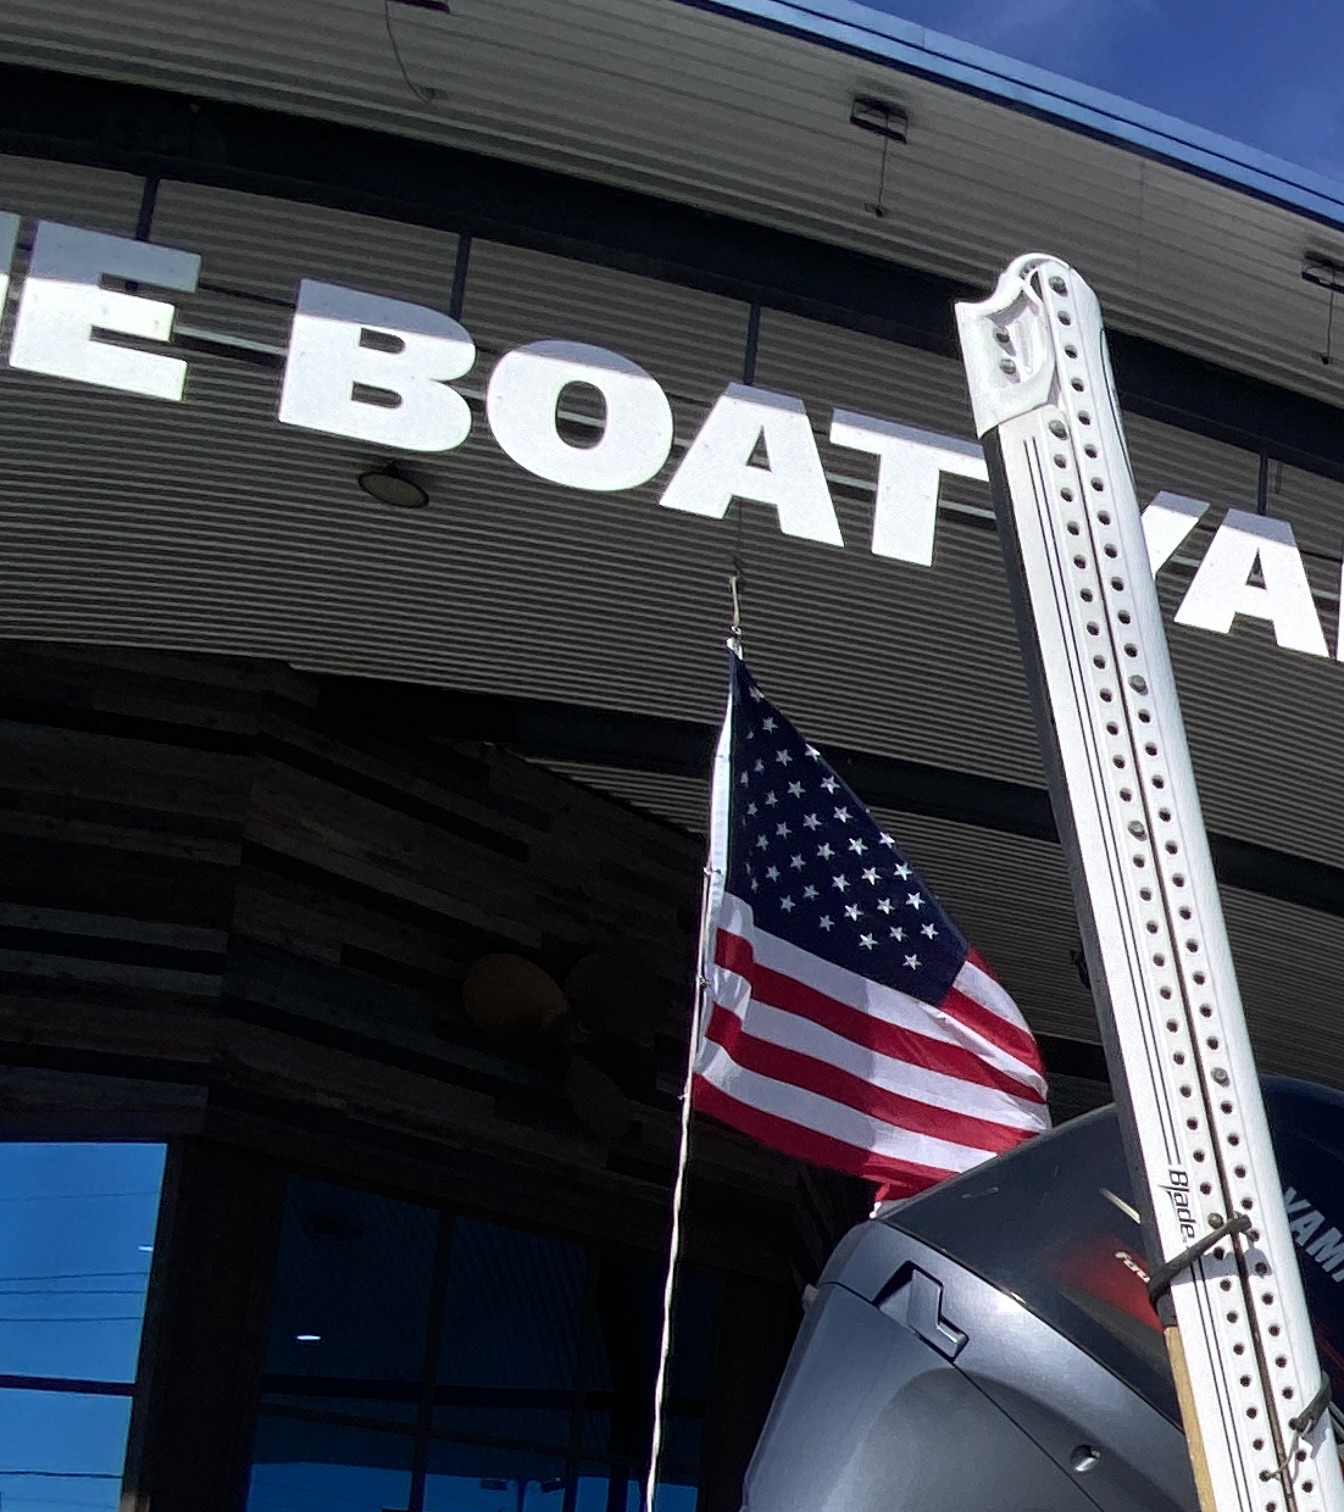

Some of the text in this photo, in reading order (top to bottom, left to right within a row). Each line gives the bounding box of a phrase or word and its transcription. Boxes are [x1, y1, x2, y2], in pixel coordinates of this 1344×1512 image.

[0, 211, 202, 402] E
[279, 278, 990, 567] BOAT
[1157, 1168, 1197, 1240] Blade
